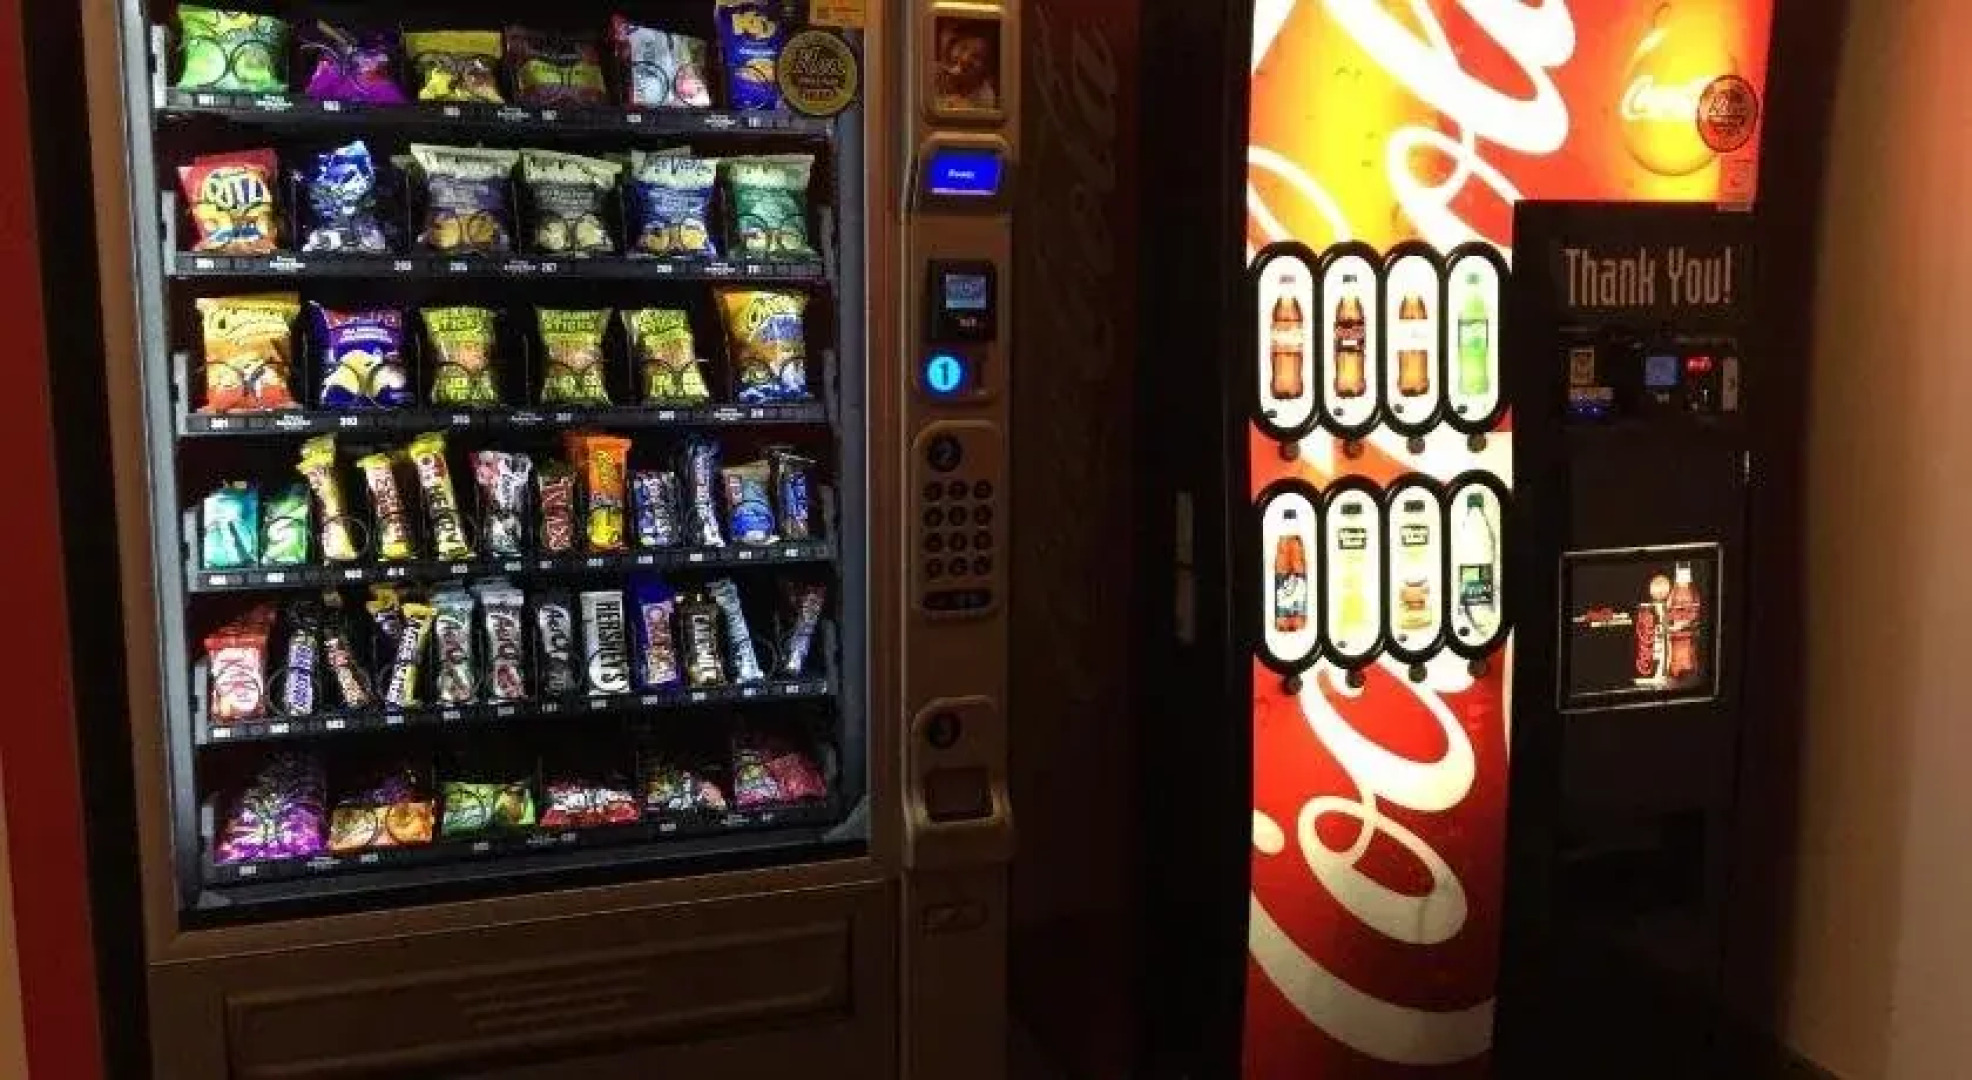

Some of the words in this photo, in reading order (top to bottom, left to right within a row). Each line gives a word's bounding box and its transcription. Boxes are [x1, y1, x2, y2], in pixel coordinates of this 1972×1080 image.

[209, 171, 265, 210] RITZ
[1565, 246, 1656, 306] Thank
[1668, 246, 1732, 305] You!
[938, 360, 951, 386] 1
